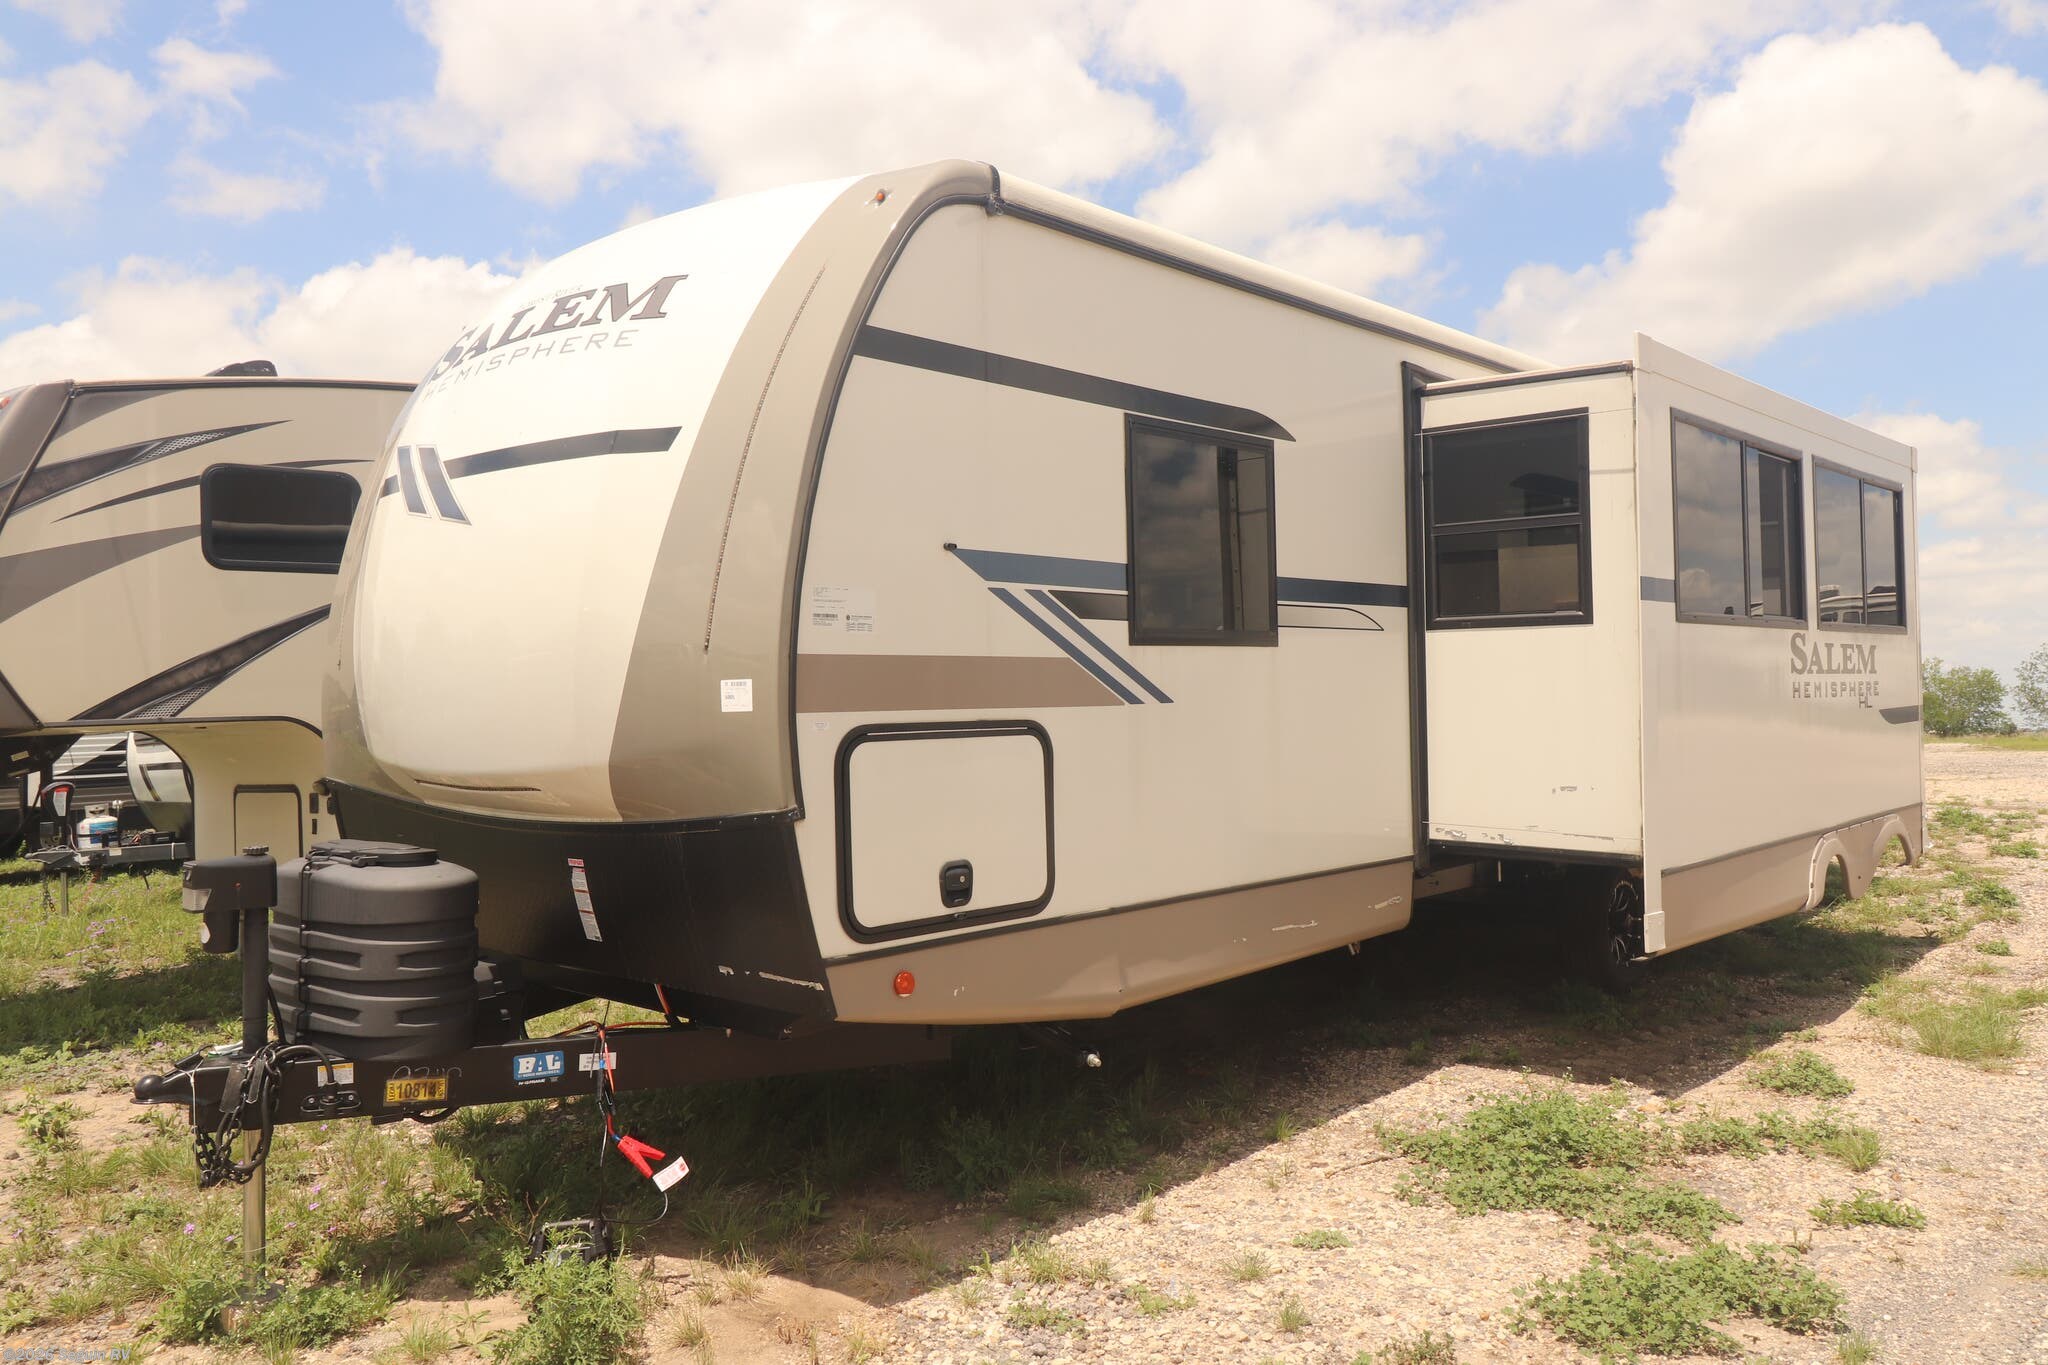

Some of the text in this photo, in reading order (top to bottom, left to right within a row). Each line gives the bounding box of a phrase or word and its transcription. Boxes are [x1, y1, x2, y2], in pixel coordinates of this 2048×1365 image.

[431, 274, 689, 384] SALEM
[422, 329, 640, 402] HEMISPHERE
[1790, 632, 1877, 675] SALEM
[1792, 681, 1879, 698] HEMISPHERE
